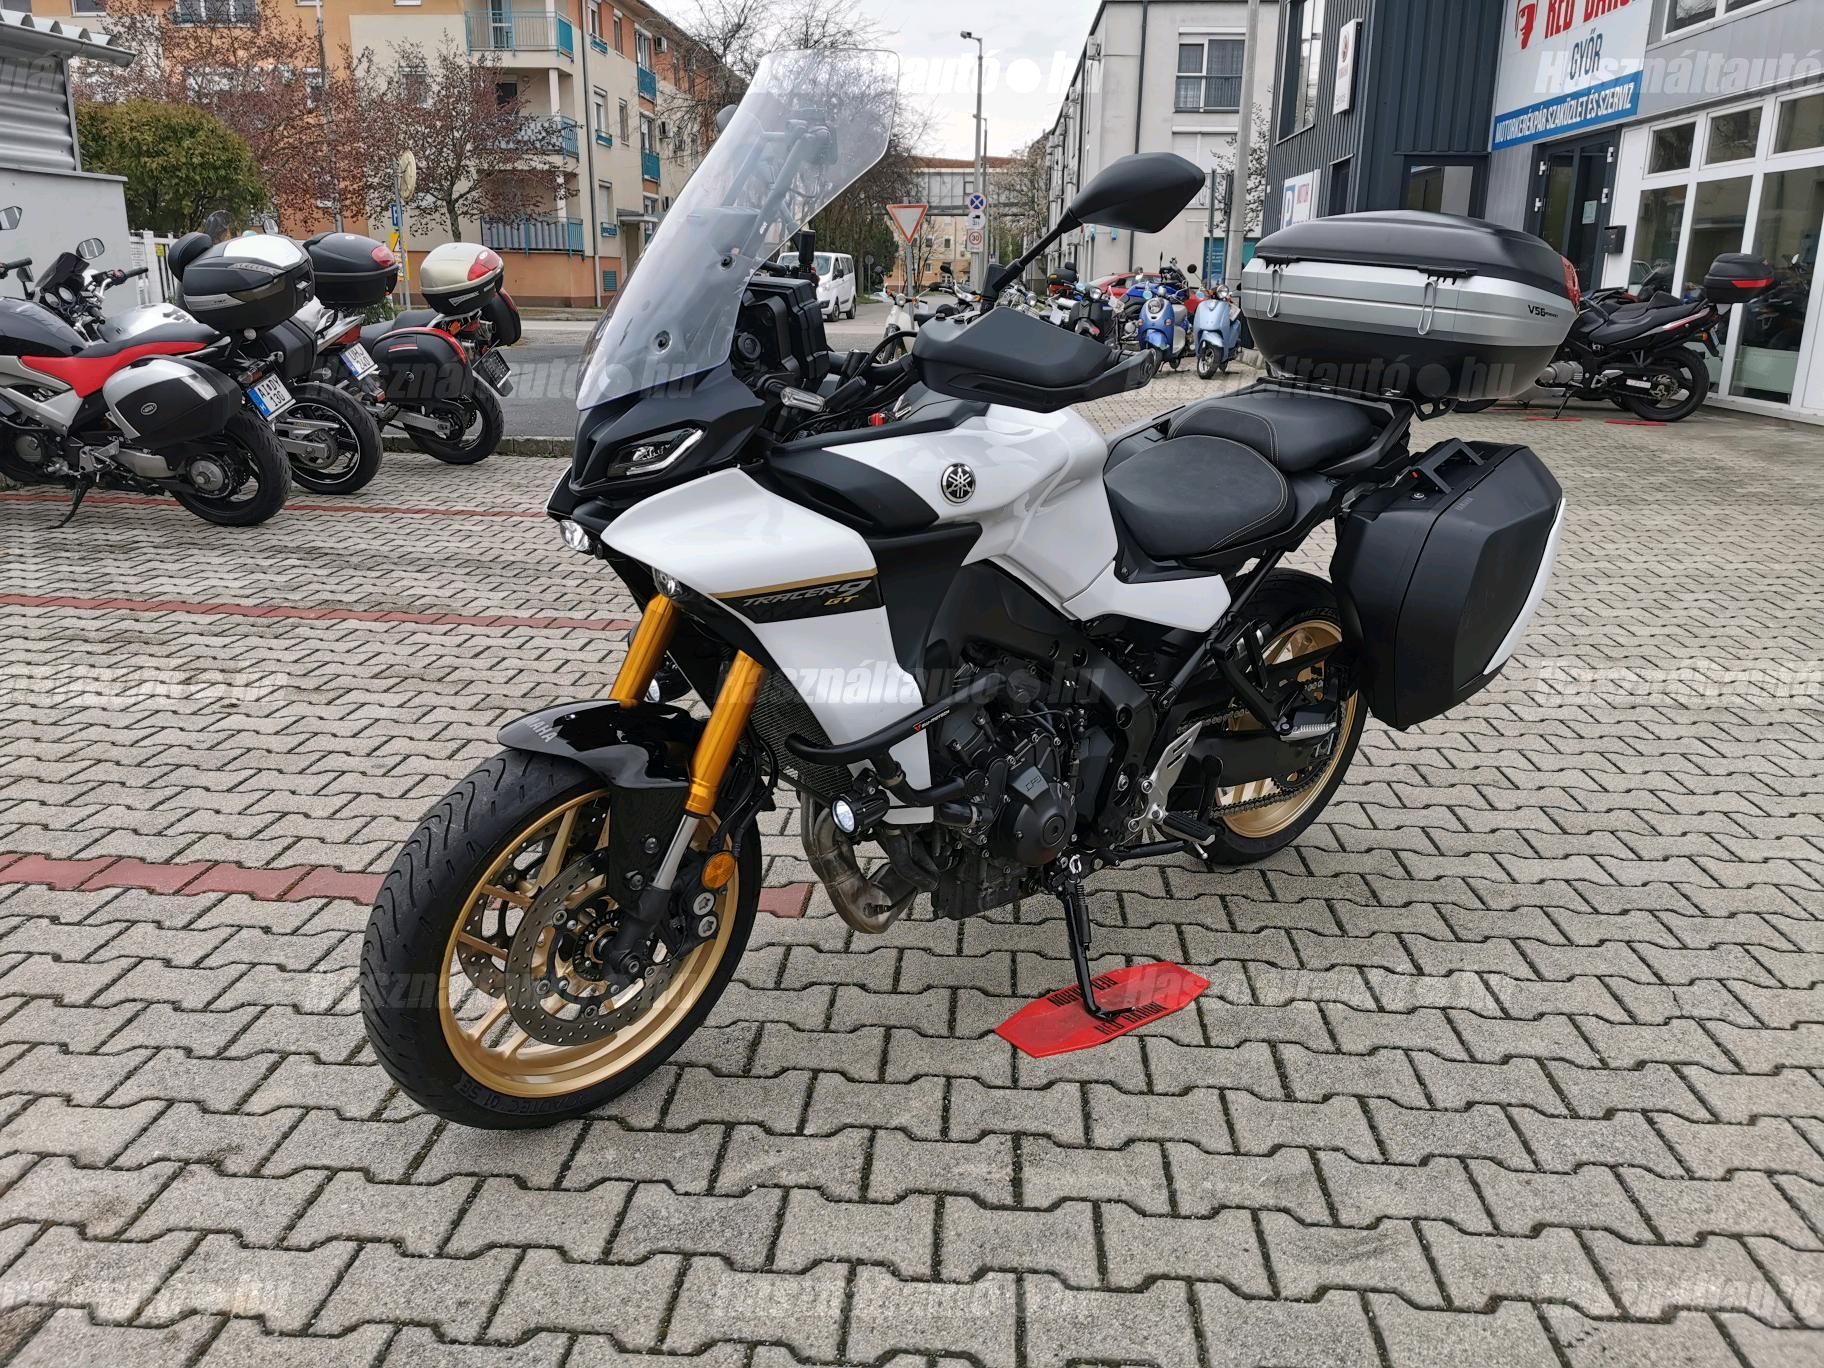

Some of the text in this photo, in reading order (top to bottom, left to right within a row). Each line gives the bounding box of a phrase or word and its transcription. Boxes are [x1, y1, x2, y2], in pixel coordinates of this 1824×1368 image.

[1569, 27, 1603, 80] GYŐR
[1546, 96, 1587, 129] SZAKÜZLET
[1587, 89, 1599, 119] ÉS
[1598, 82, 1635, 115] SZERVIZ
[270, 390, 286, 407] 130
[823, 595, 860, 606] GT
